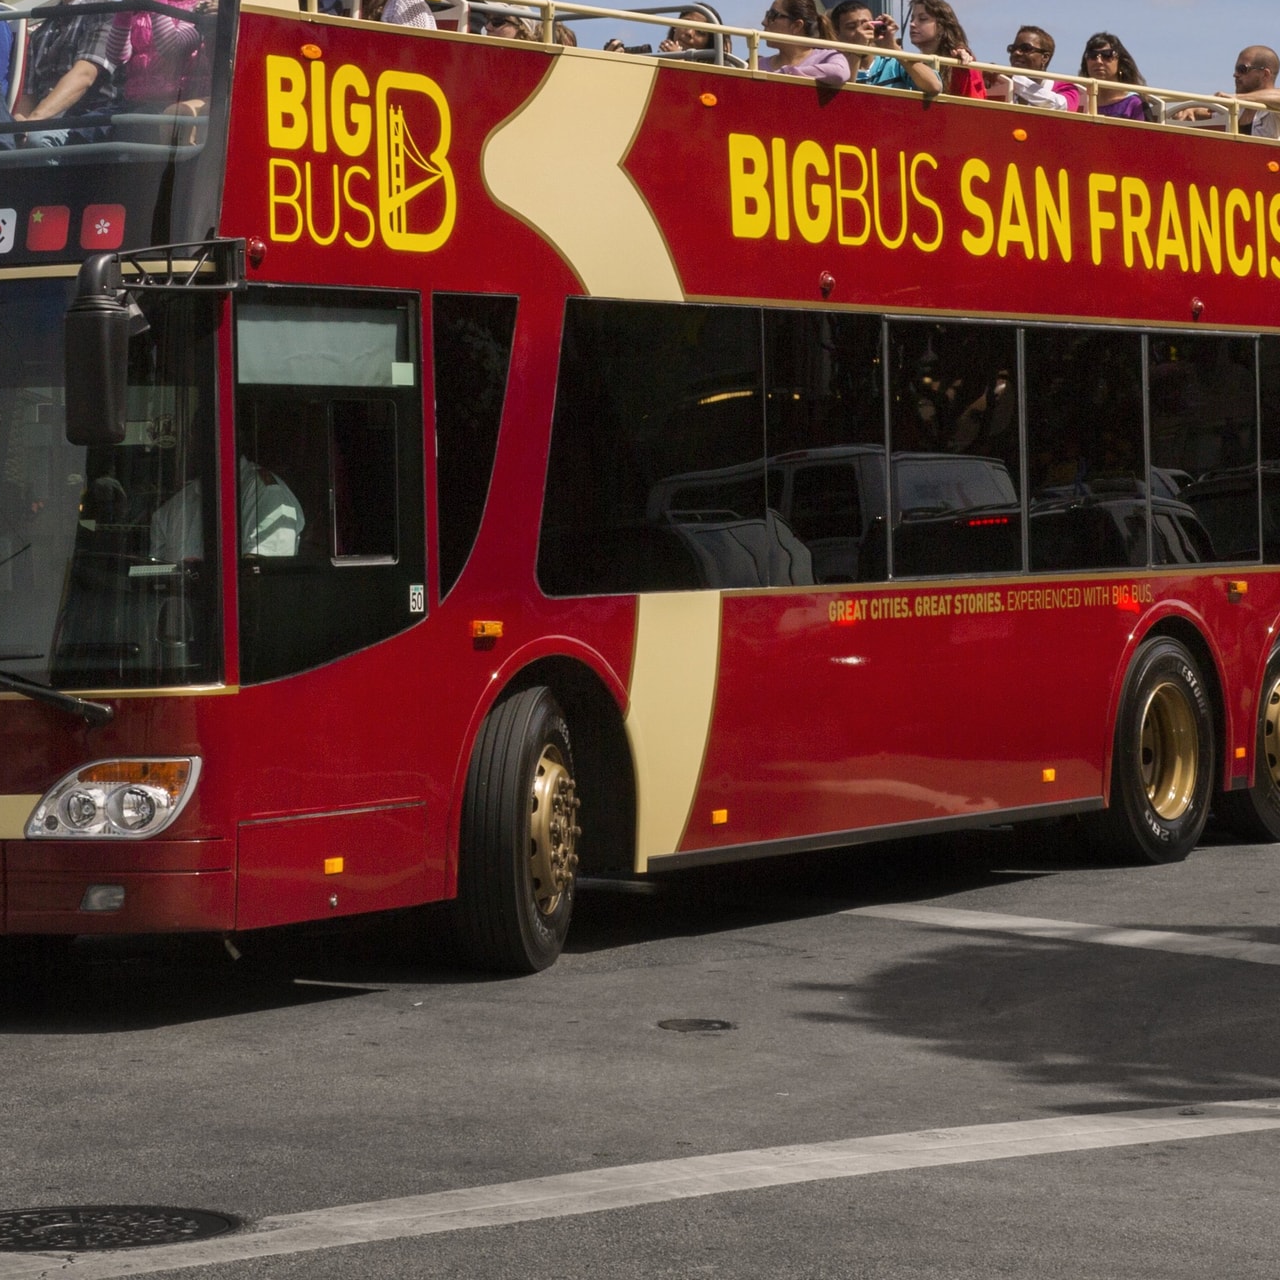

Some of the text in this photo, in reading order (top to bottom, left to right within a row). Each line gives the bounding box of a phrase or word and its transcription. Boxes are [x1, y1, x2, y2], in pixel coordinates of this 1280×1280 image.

[266, 54, 372, 157] BIG
[269, 157, 375, 249] BUS
[960, 157, 1072, 263] SAN
[411, 591, 423, 610] 50
[828, 583, 1155, 622] GREAT CITIES. GREAT STORIES. EXPERIENCED WITH BIG BUS.
